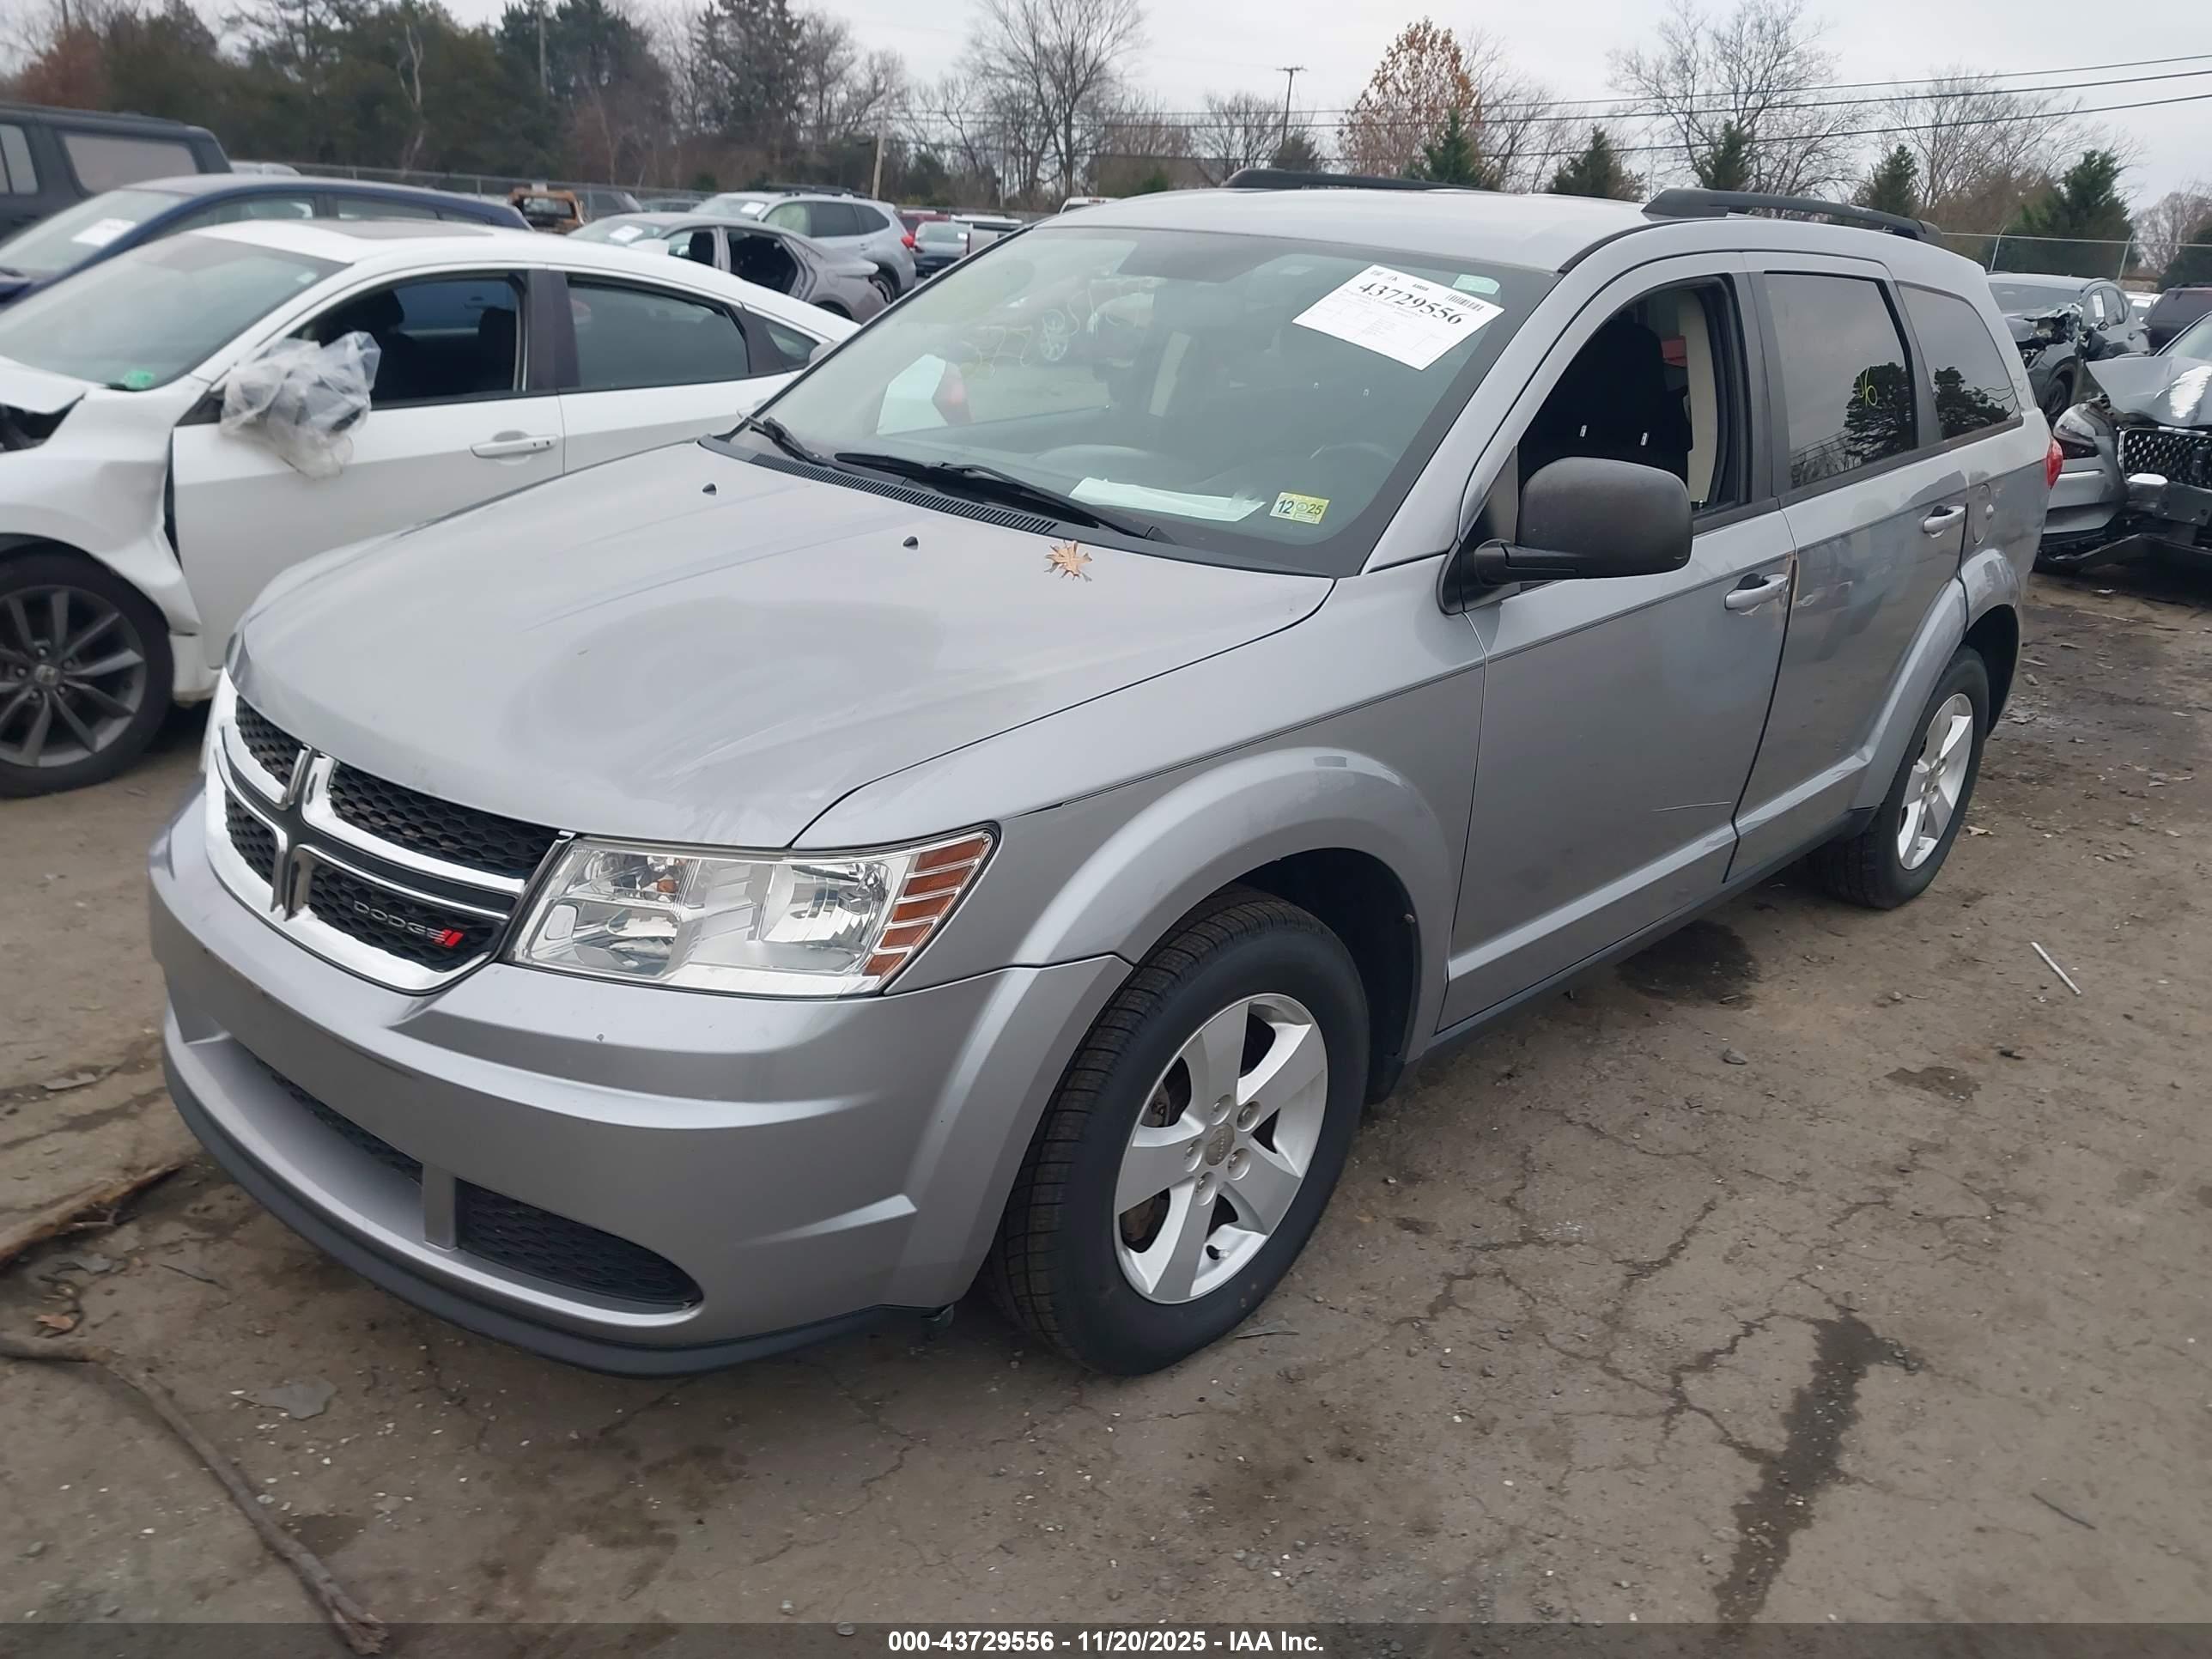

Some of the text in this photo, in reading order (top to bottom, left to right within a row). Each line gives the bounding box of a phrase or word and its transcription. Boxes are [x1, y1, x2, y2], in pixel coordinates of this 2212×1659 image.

[1358, 283, 1468, 325] 43729556
[1278, 499, 1324, 515] 12 25
[354, 900, 446, 944] DODGE
